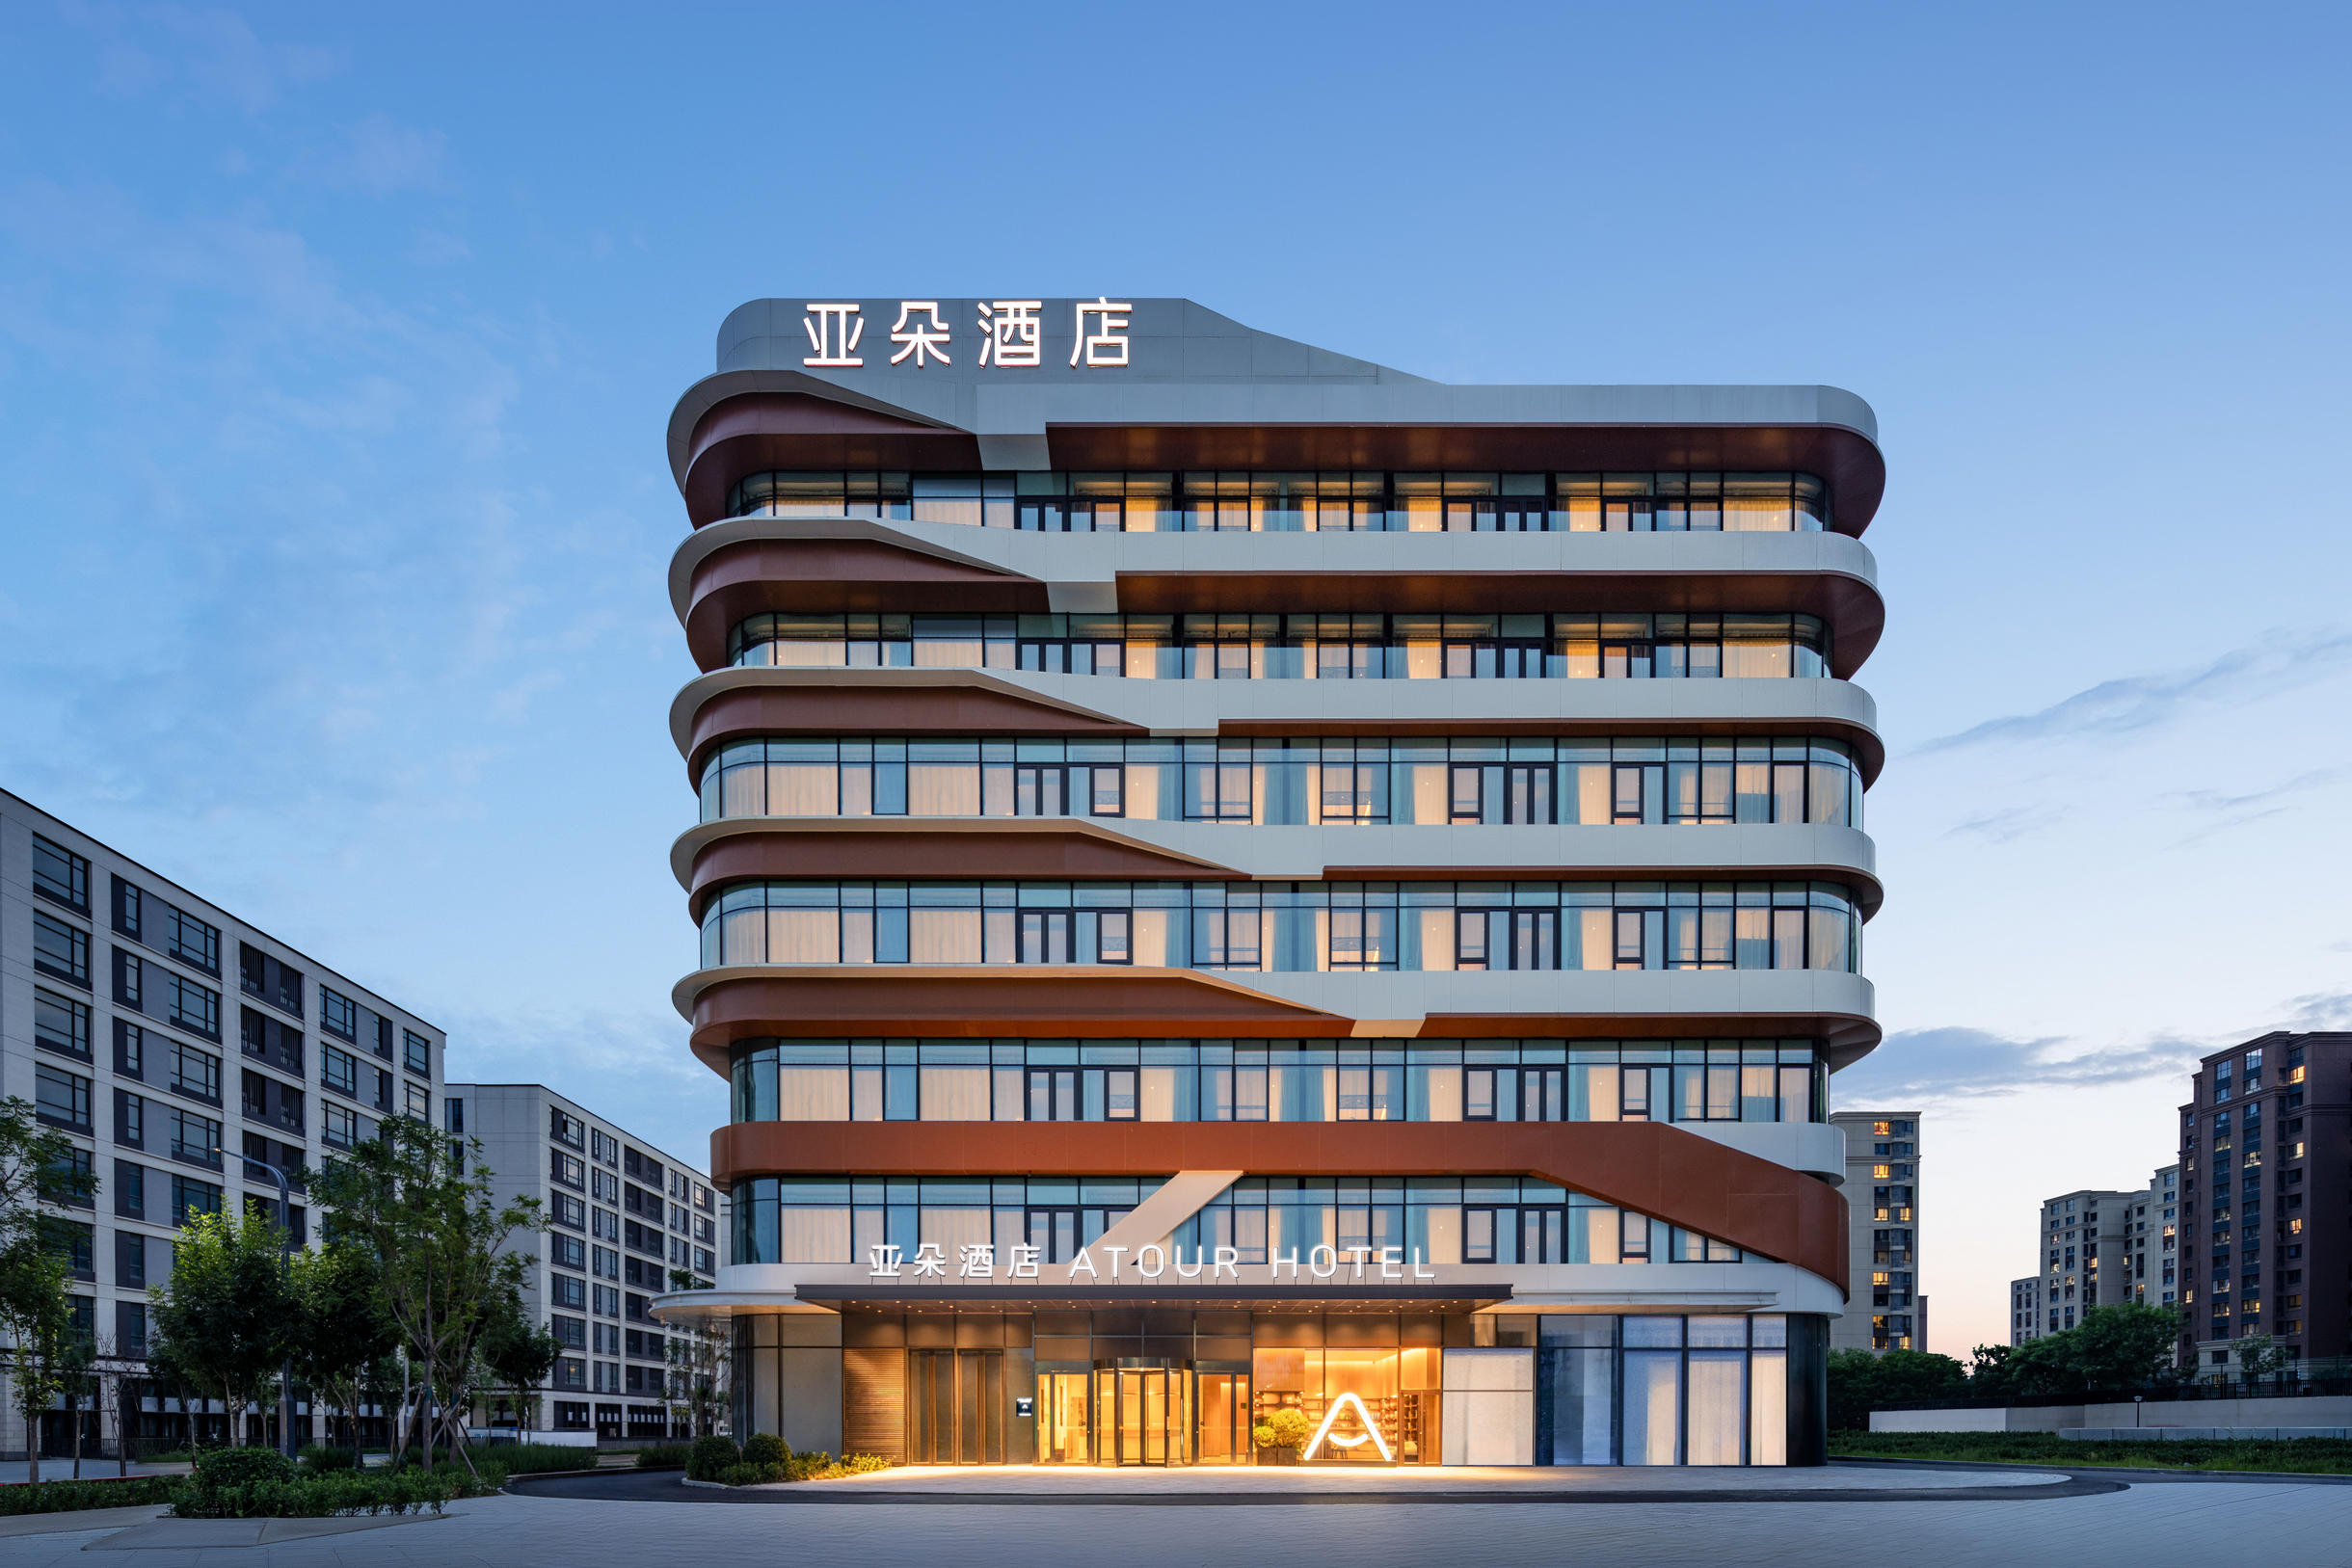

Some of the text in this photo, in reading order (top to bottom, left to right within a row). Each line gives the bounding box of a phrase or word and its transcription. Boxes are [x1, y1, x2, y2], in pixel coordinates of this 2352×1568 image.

[803, 296, 1133, 368] 亚朵酒店
[869, 1242, 1436, 1279] 亚朵酒店 ATOUR HOTEL
